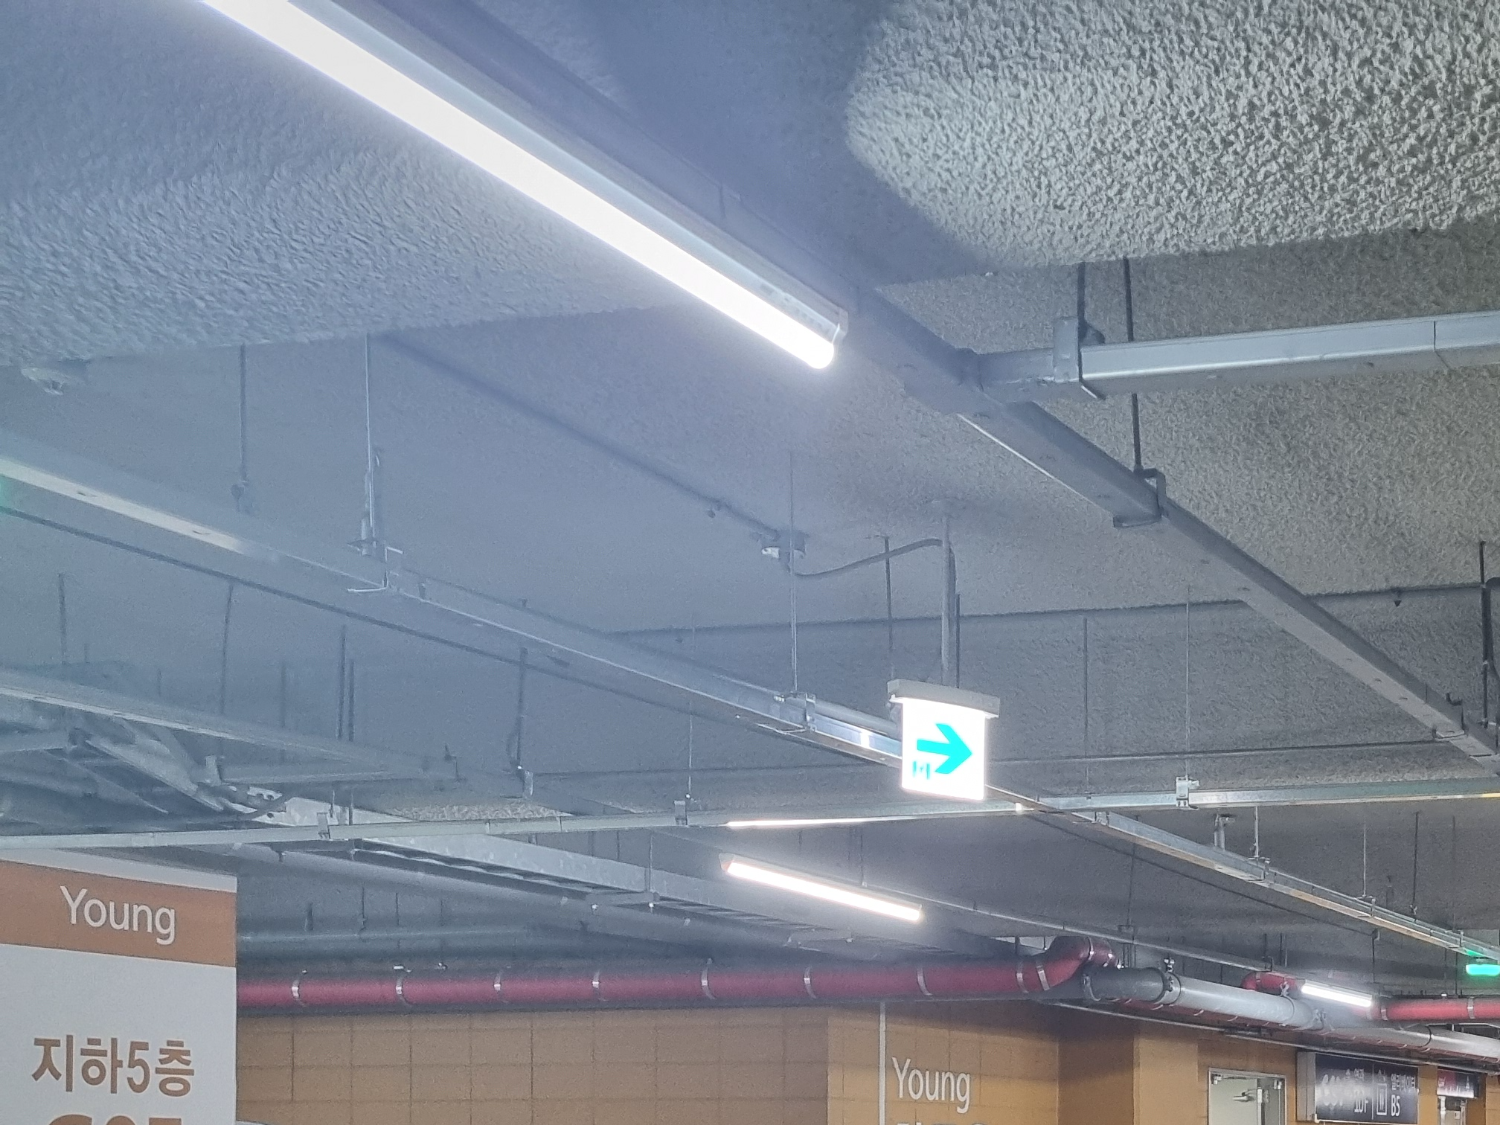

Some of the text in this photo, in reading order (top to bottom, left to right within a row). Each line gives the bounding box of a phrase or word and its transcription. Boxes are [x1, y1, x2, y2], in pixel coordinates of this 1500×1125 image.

[60, 885, 176, 945] Young
[32, 1034, 195, 1098] 지하5층
[892, 1056, 970, 1114] Young
[1390, 1094, 1401, 1117] B5
